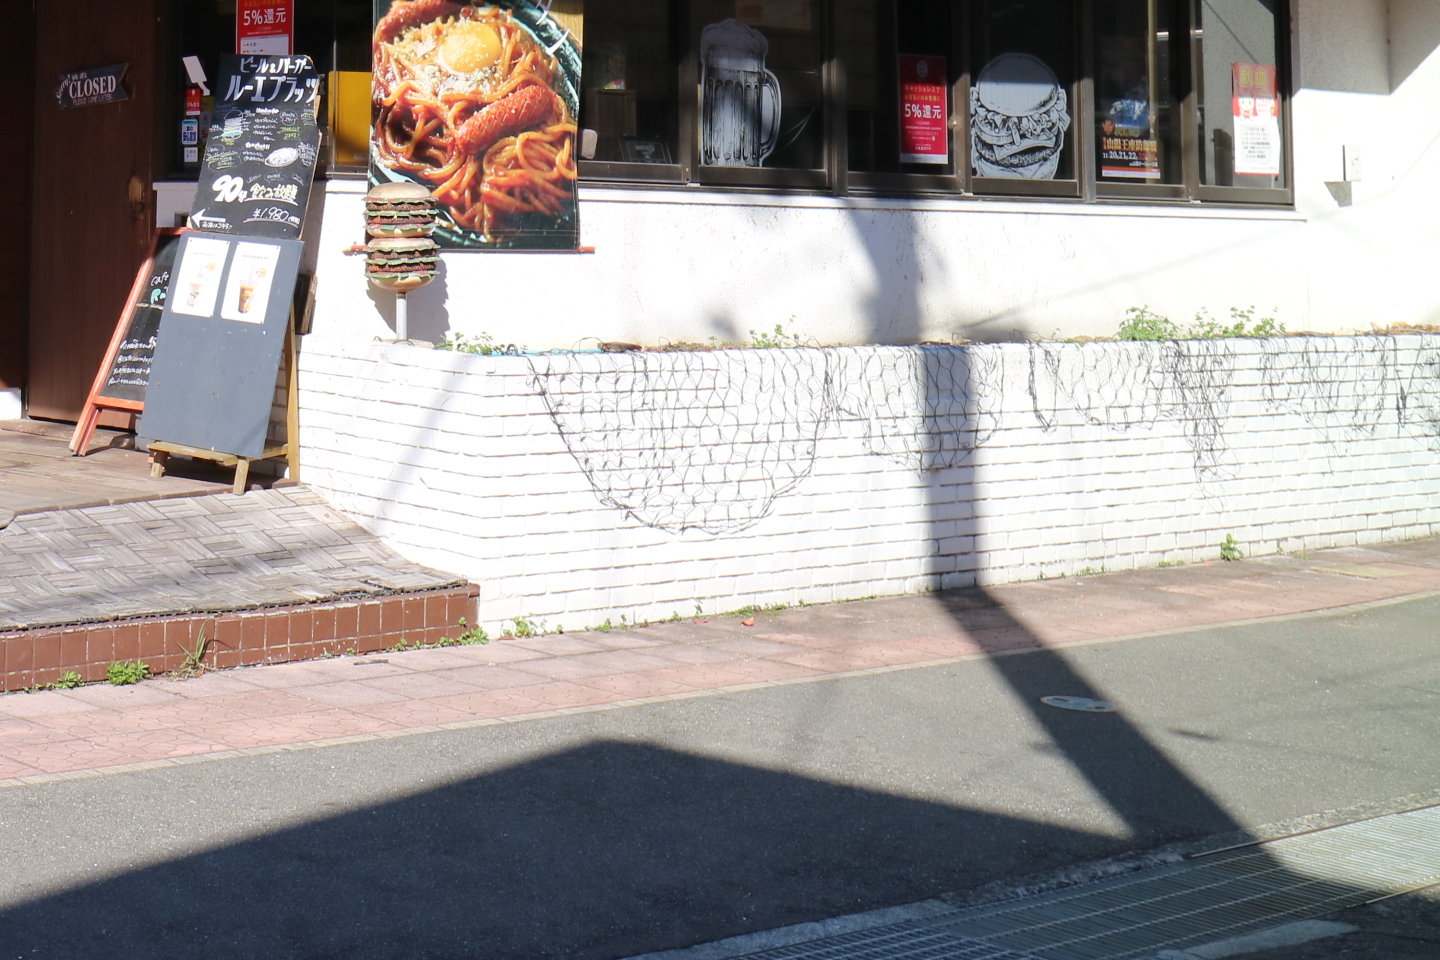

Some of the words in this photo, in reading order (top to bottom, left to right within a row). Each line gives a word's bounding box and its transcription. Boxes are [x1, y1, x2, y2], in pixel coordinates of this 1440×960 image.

[243, 7, 286, 26] 5%還元
[69, 75, 117, 99] CLOSED
[224, 75, 319, 103] ルーエプラッツ
[904, 84, 941, 94] キャッシュレスで
[904, 104, 942, 119] 5%還元
